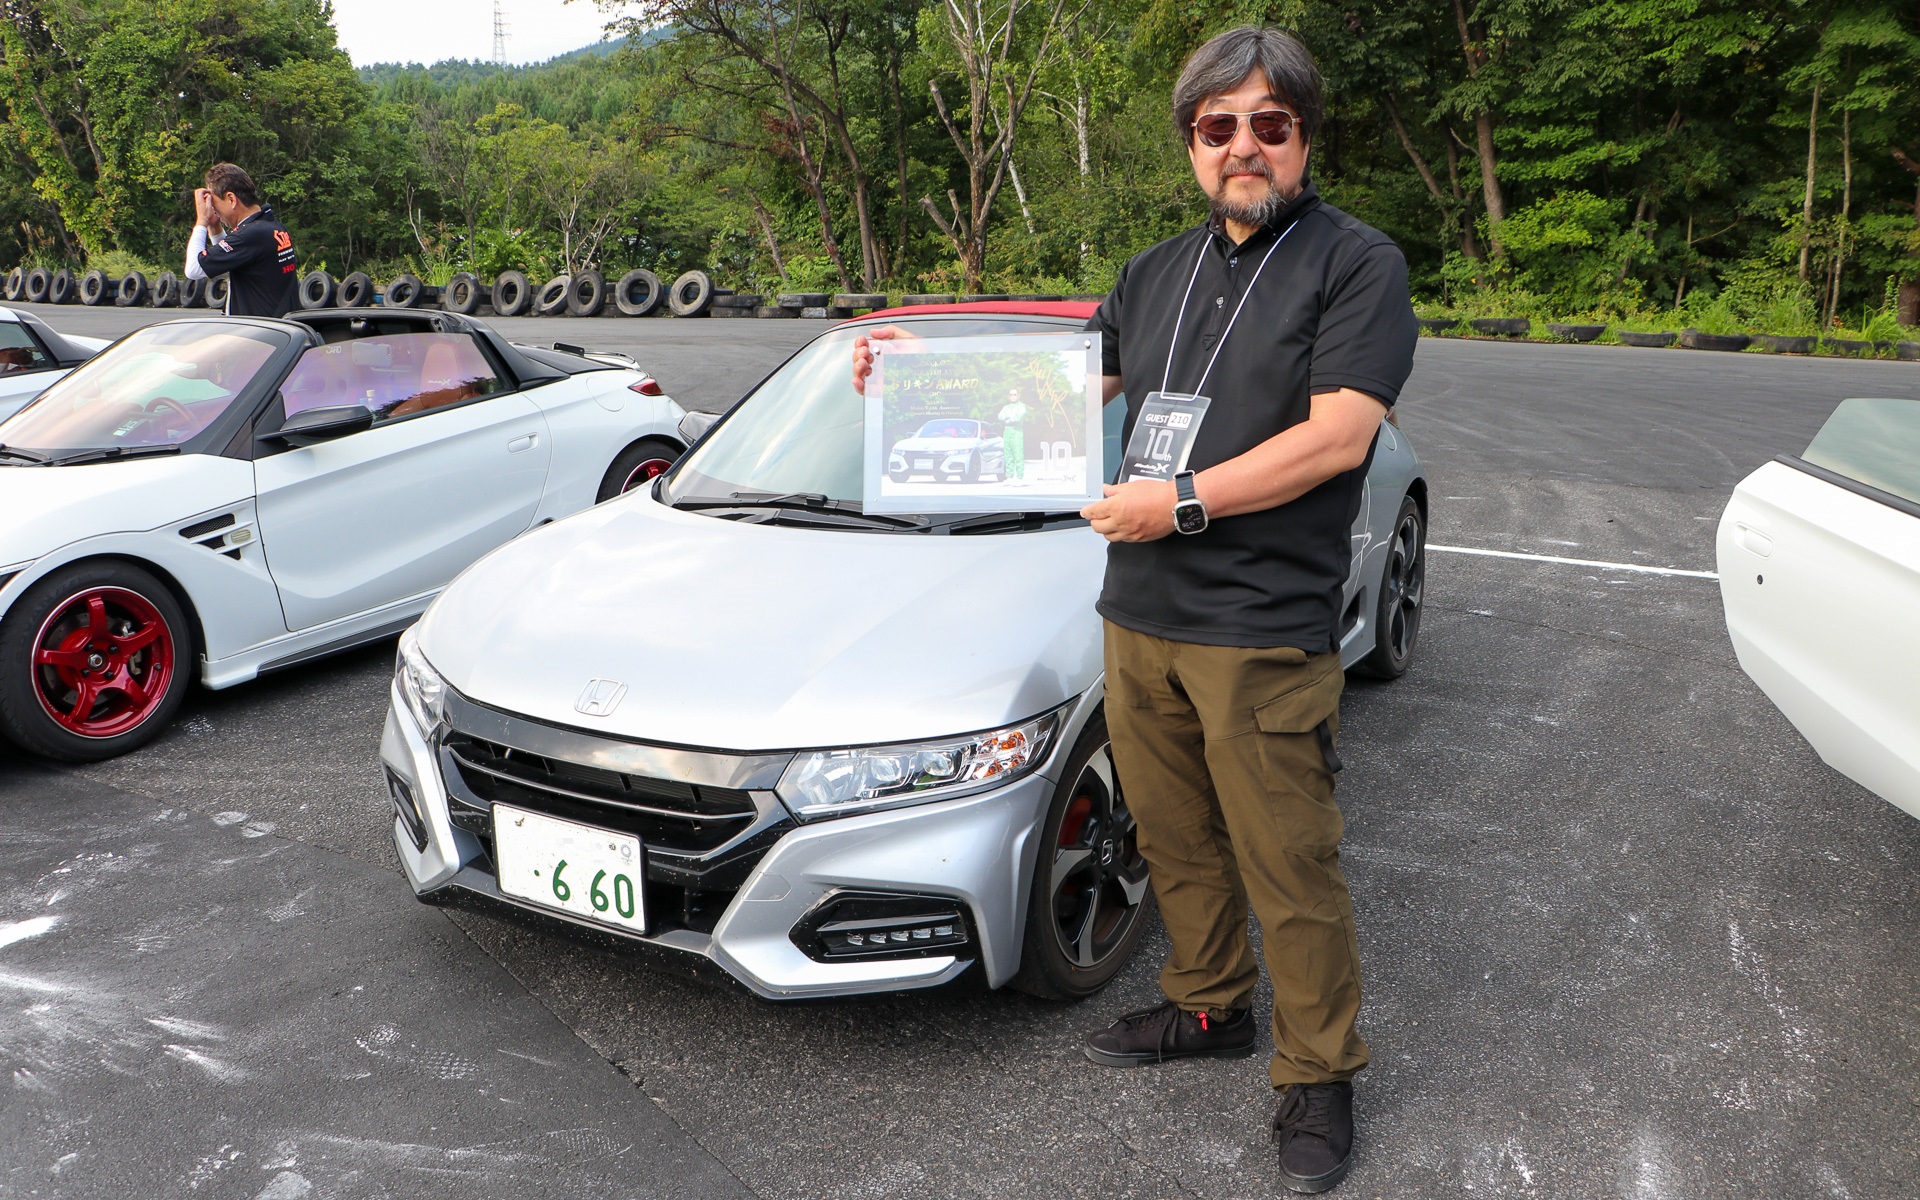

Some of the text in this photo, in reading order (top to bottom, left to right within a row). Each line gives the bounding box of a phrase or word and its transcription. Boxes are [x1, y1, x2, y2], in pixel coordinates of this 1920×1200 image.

[936, 378, 979, 390] AWARD
[1145, 413, 1189, 425] GUEST 210
[1040, 441, 1072, 472] 10
